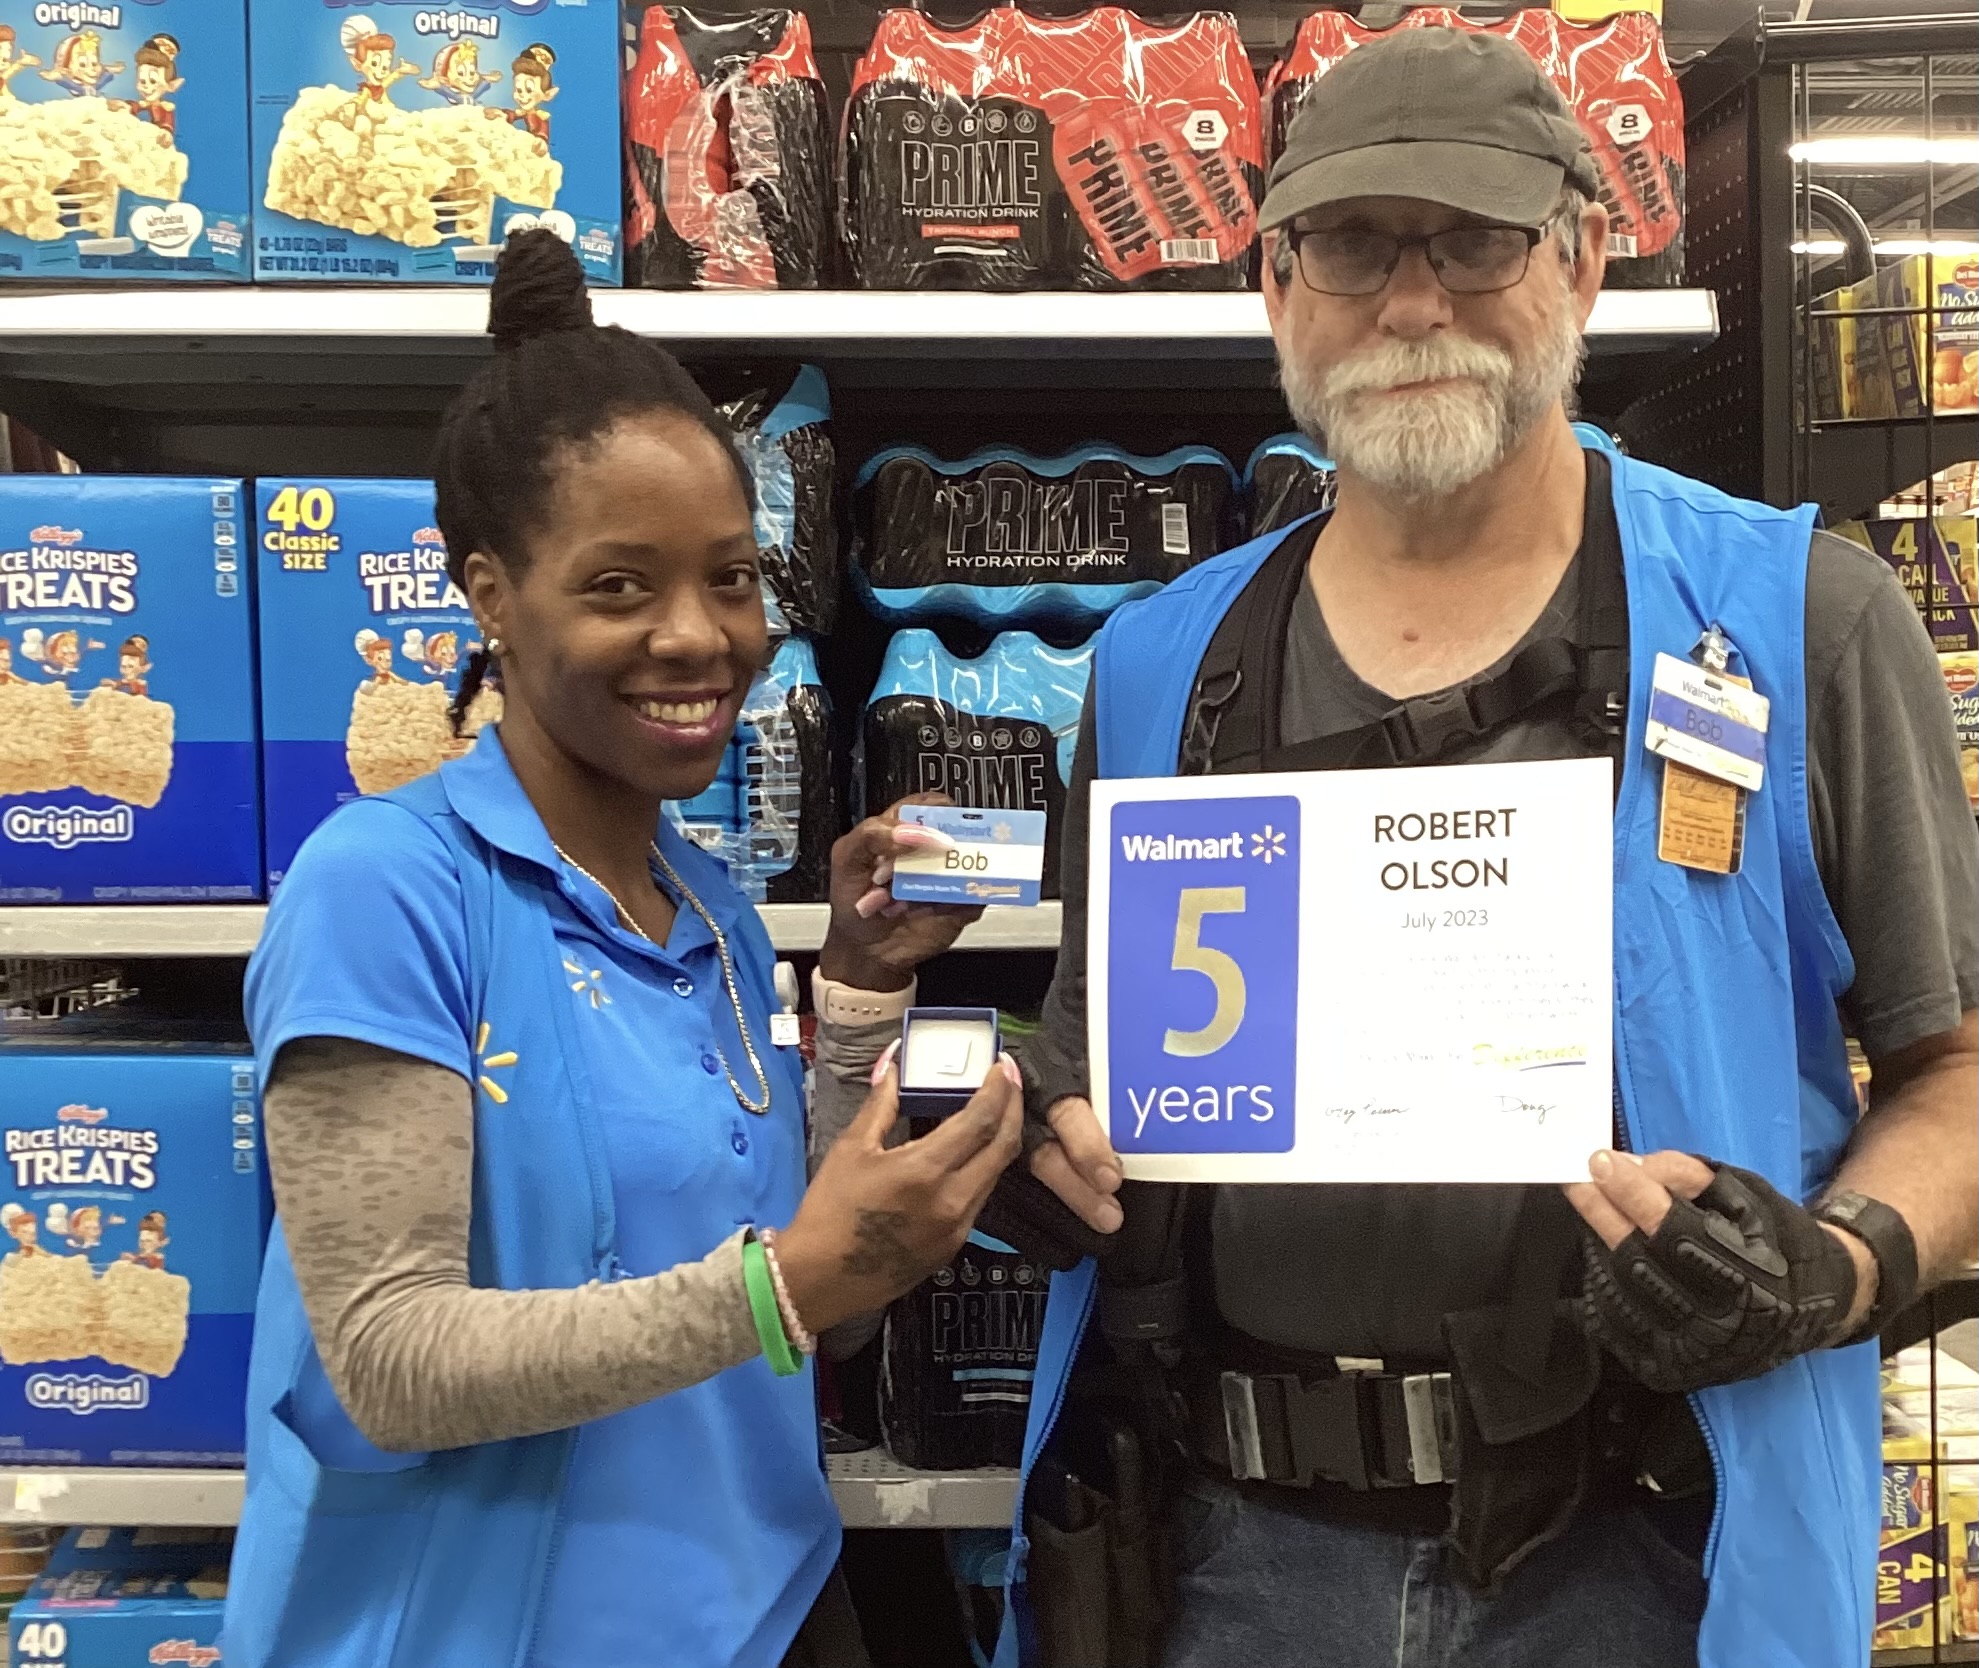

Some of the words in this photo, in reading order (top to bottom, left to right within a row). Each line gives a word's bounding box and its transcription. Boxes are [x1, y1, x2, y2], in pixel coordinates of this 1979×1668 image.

[35, 2, 120, 29] Original
[414, 11, 498, 38] Original
[1196, 119, 1215, 135] 8
[1620, 113, 1639, 129] 8
[901, 140, 1041, 207] PRIME
[902, 207, 988, 219] HYDRATION
[992, 207, 1040, 219] DRINK
[267, 486, 335, 532] 40
[946, 477, 1130, 555] PRIME
[264, 531, 340, 551] Classic
[1891, 522, 1919, 562] 4
[31, 546, 138, 576] KRISPIES
[282, 552, 328, 570] SIZE
[360, 552, 411, 577] RICE
[946, 555, 1061, 568] HYDRATION
[1066, 554, 1127, 567] DRINK
[364, 573, 470, 612] TREA
[1681, 680, 1725, 708] Walmart
[1950, 694, 1979, 716] Sug
[1685, 708, 1723, 742] Bob
[918, 752, 1048, 812] PRIME
[12, 813, 126, 840] Original
[1375, 808, 1517, 843] ROBERT
[945, 849, 989, 871] Bob
[1121, 831, 1244, 862] Walmart
[1381, 857, 1508, 891] OLSON
[1401, 911, 1437, 933] July
[1443, 909, 1489, 927] 2023
[1162, 886, 1246, 1058] 5
[1128, 1084, 1275, 1139] years
[1494, 1095, 1557, 1125] Doug
[5, 1130, 56, 1152] RICE
[58, 1125, 159, 1154] KRISPIES
[9, 1150, 155, 1190] TREATS
[932, 1290, 1050, 1352] PRIM
[33, 1379, 141, 1406] Original
[1877, 1560, 1902, 1605] CAN
[1903, 1553, 1947, 1584] 4
[17, 1622, 67, 1659] 40
